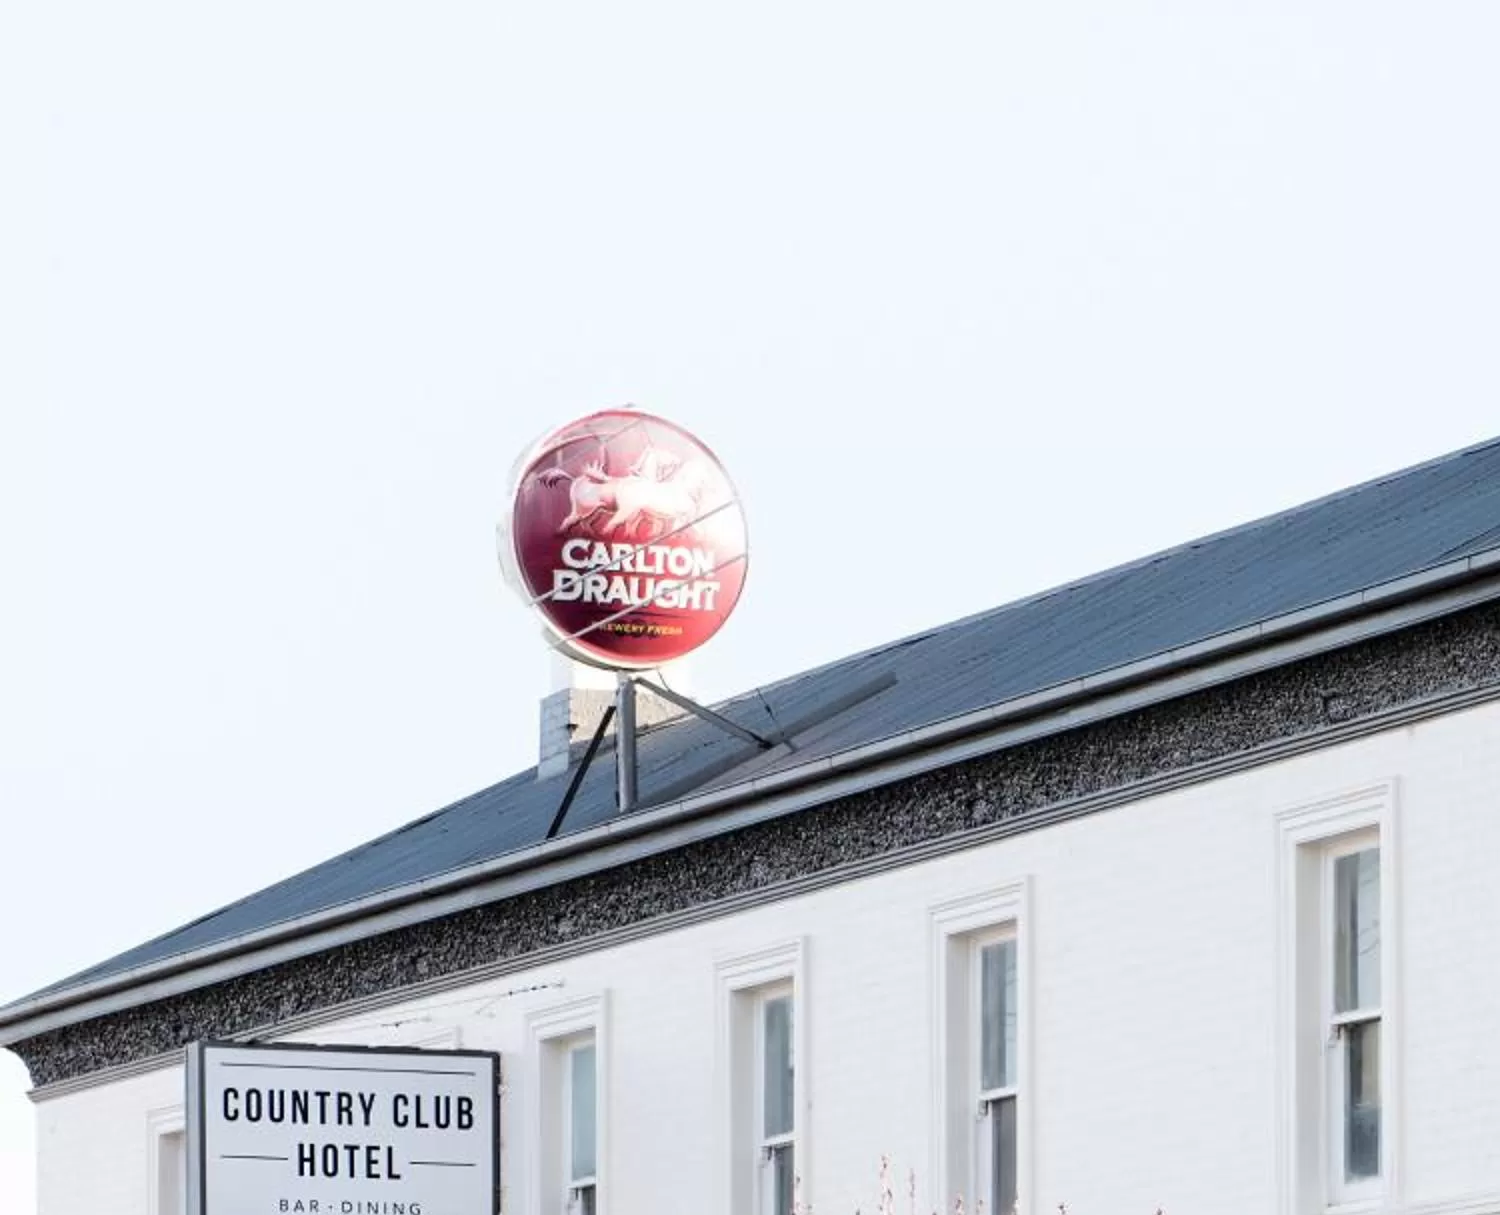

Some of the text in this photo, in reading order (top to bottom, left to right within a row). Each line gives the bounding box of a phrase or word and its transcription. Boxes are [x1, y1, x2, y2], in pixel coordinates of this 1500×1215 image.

[561, 538, 715, 577] CARLTON
[552, 568, 721, 612] DRAUGHT
[222, 1087, 475, 1131] COUNTRY CLUB
[297, 1142, 402, 1180] HOTEL
[278, 1199, 320, 1213] BAR
